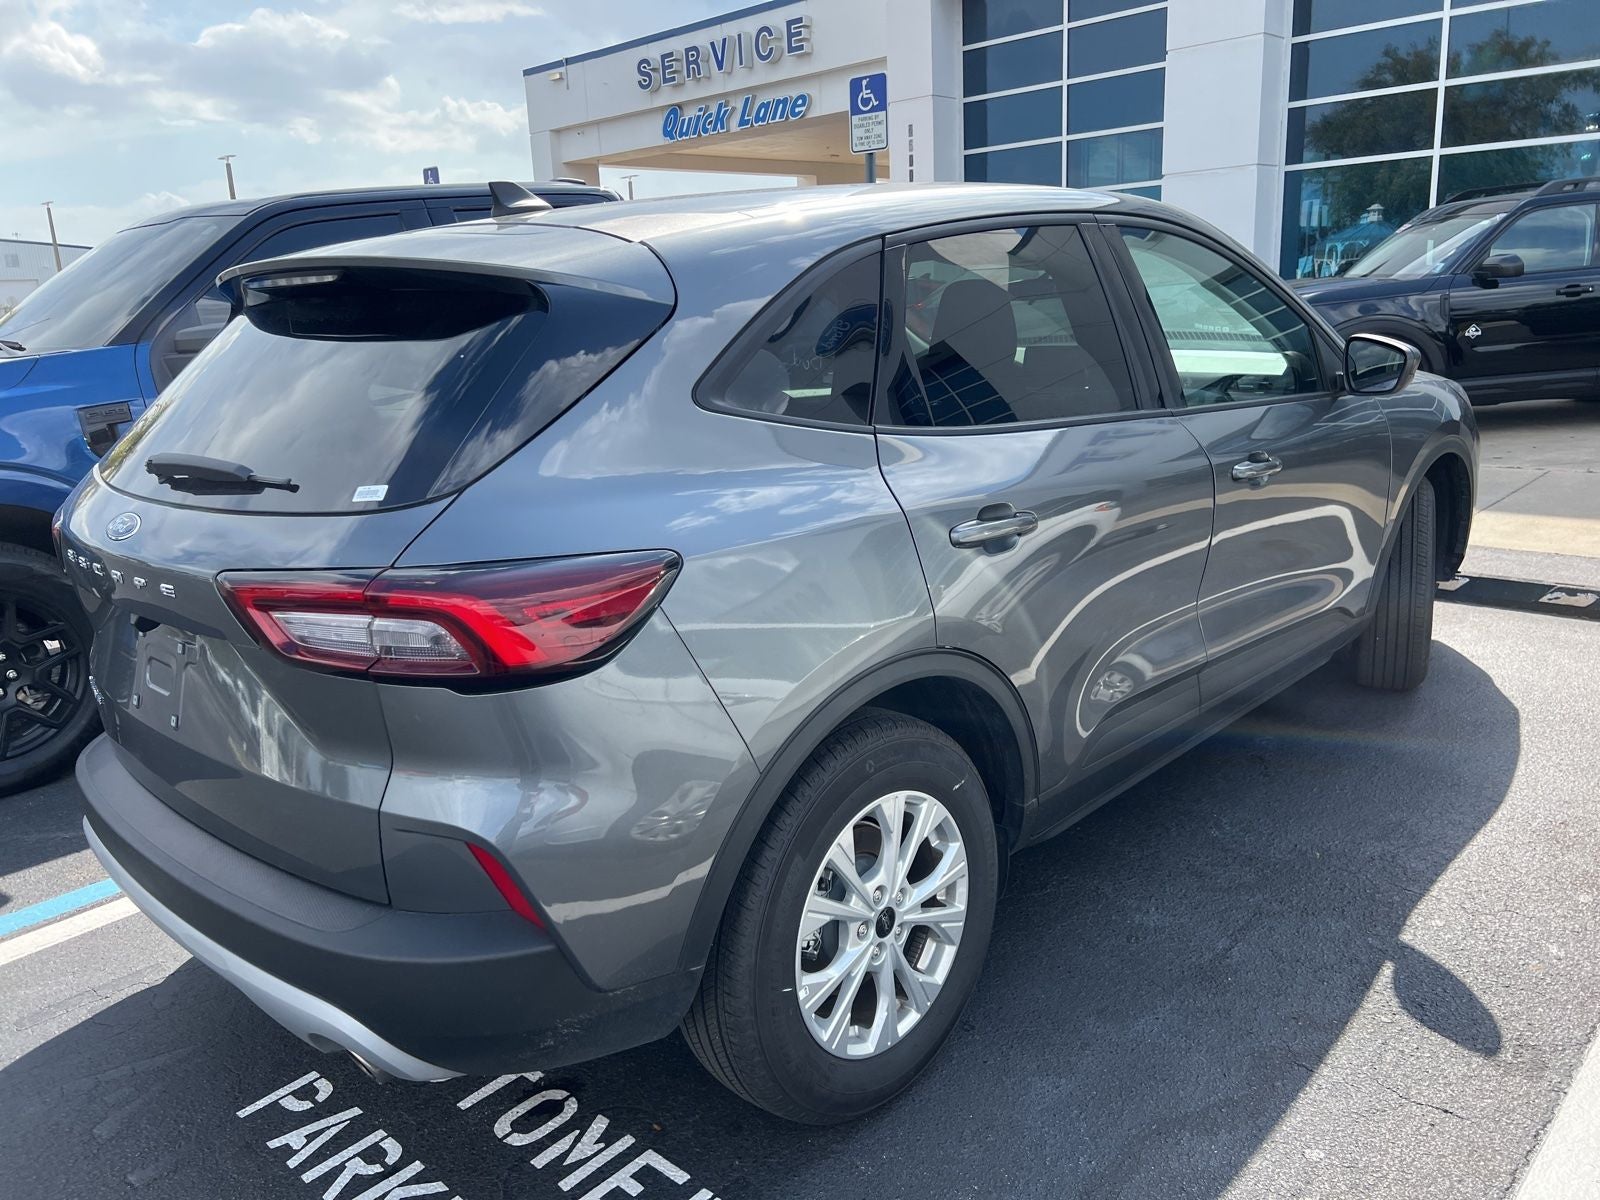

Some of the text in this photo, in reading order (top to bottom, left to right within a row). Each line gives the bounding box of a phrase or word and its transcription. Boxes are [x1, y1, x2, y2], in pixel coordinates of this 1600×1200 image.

[636, 15, 811, 92] SERVICE
[661, 91, 809, 143] Quick Lane
[67, 548, 176, 599] ESCAPE
[236, 1070, 466, 1200] PARK
